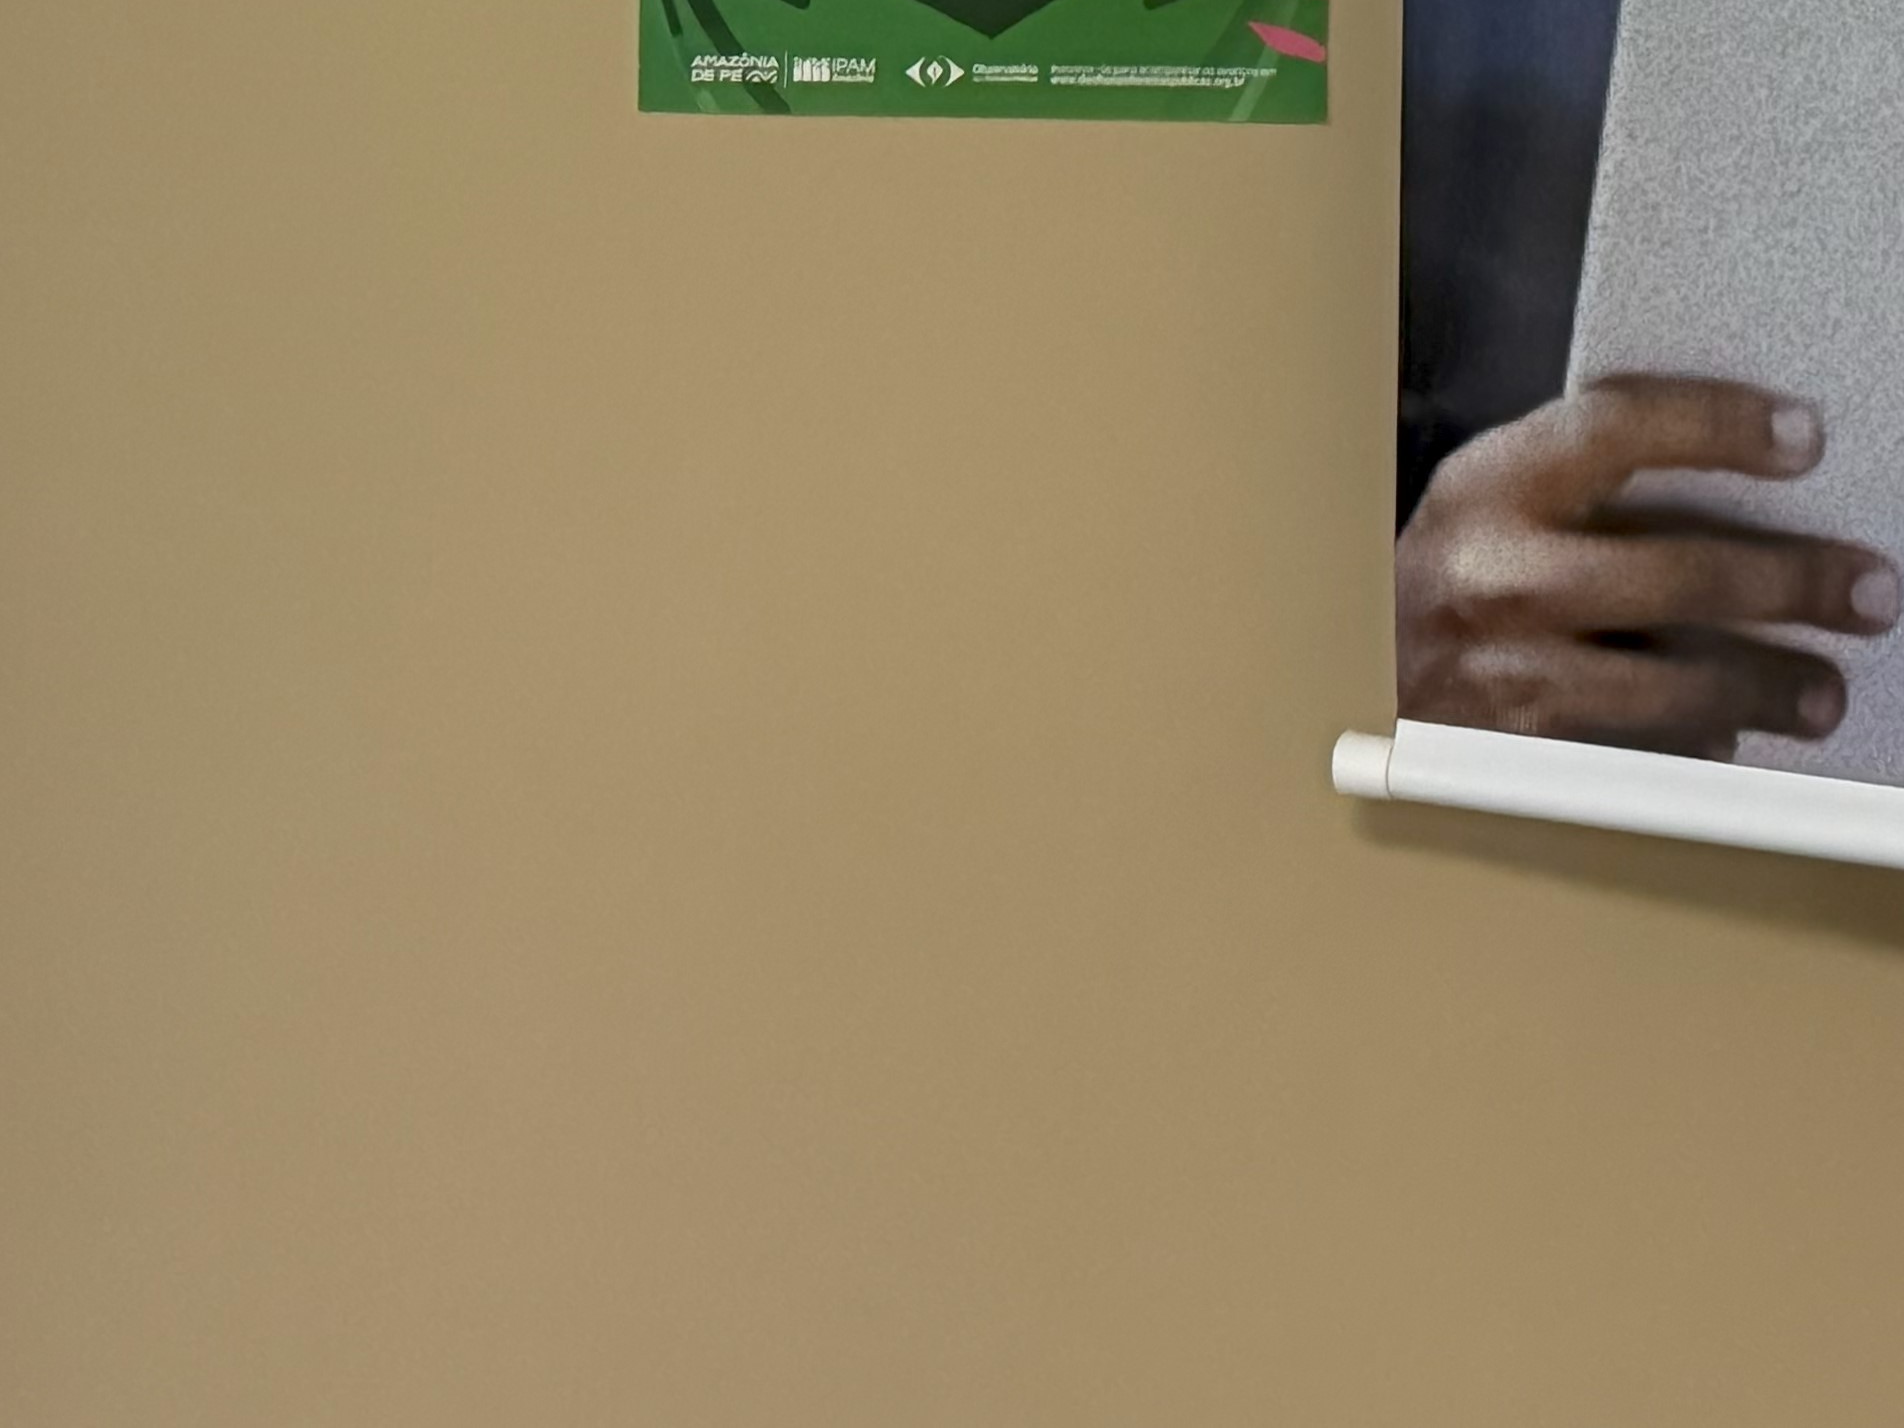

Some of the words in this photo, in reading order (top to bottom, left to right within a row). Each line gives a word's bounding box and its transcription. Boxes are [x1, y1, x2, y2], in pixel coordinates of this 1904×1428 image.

[691, 52, 779, 68] AMAZÔNIA
[832, 57, 876, 73] IPAM
[691, 69, 715, 82] DE
